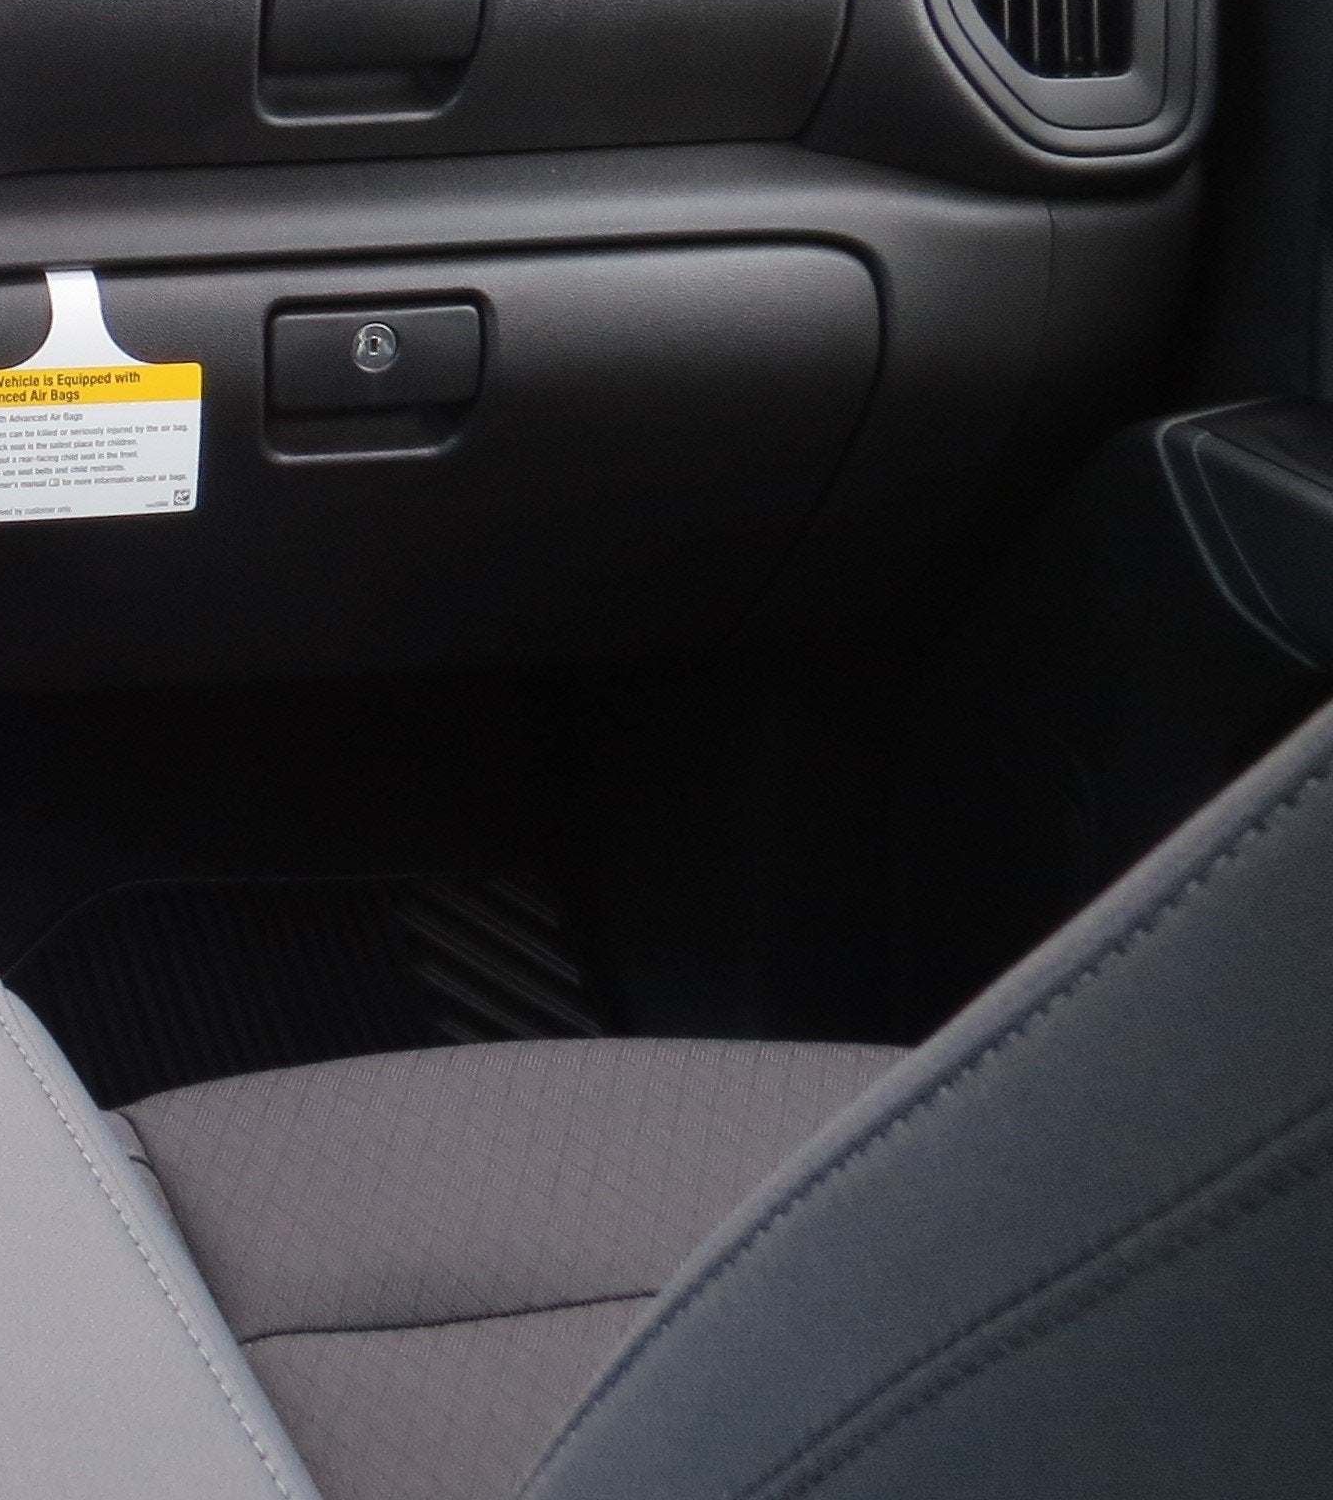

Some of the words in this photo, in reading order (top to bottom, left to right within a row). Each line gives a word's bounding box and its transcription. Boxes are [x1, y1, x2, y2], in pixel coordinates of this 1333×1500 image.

[56, 372, 112, 388] Equipped
[114, 371, 141, 384] with
[30, 389, 48, 401] Air
[50, 388, 80, 403] Bags
